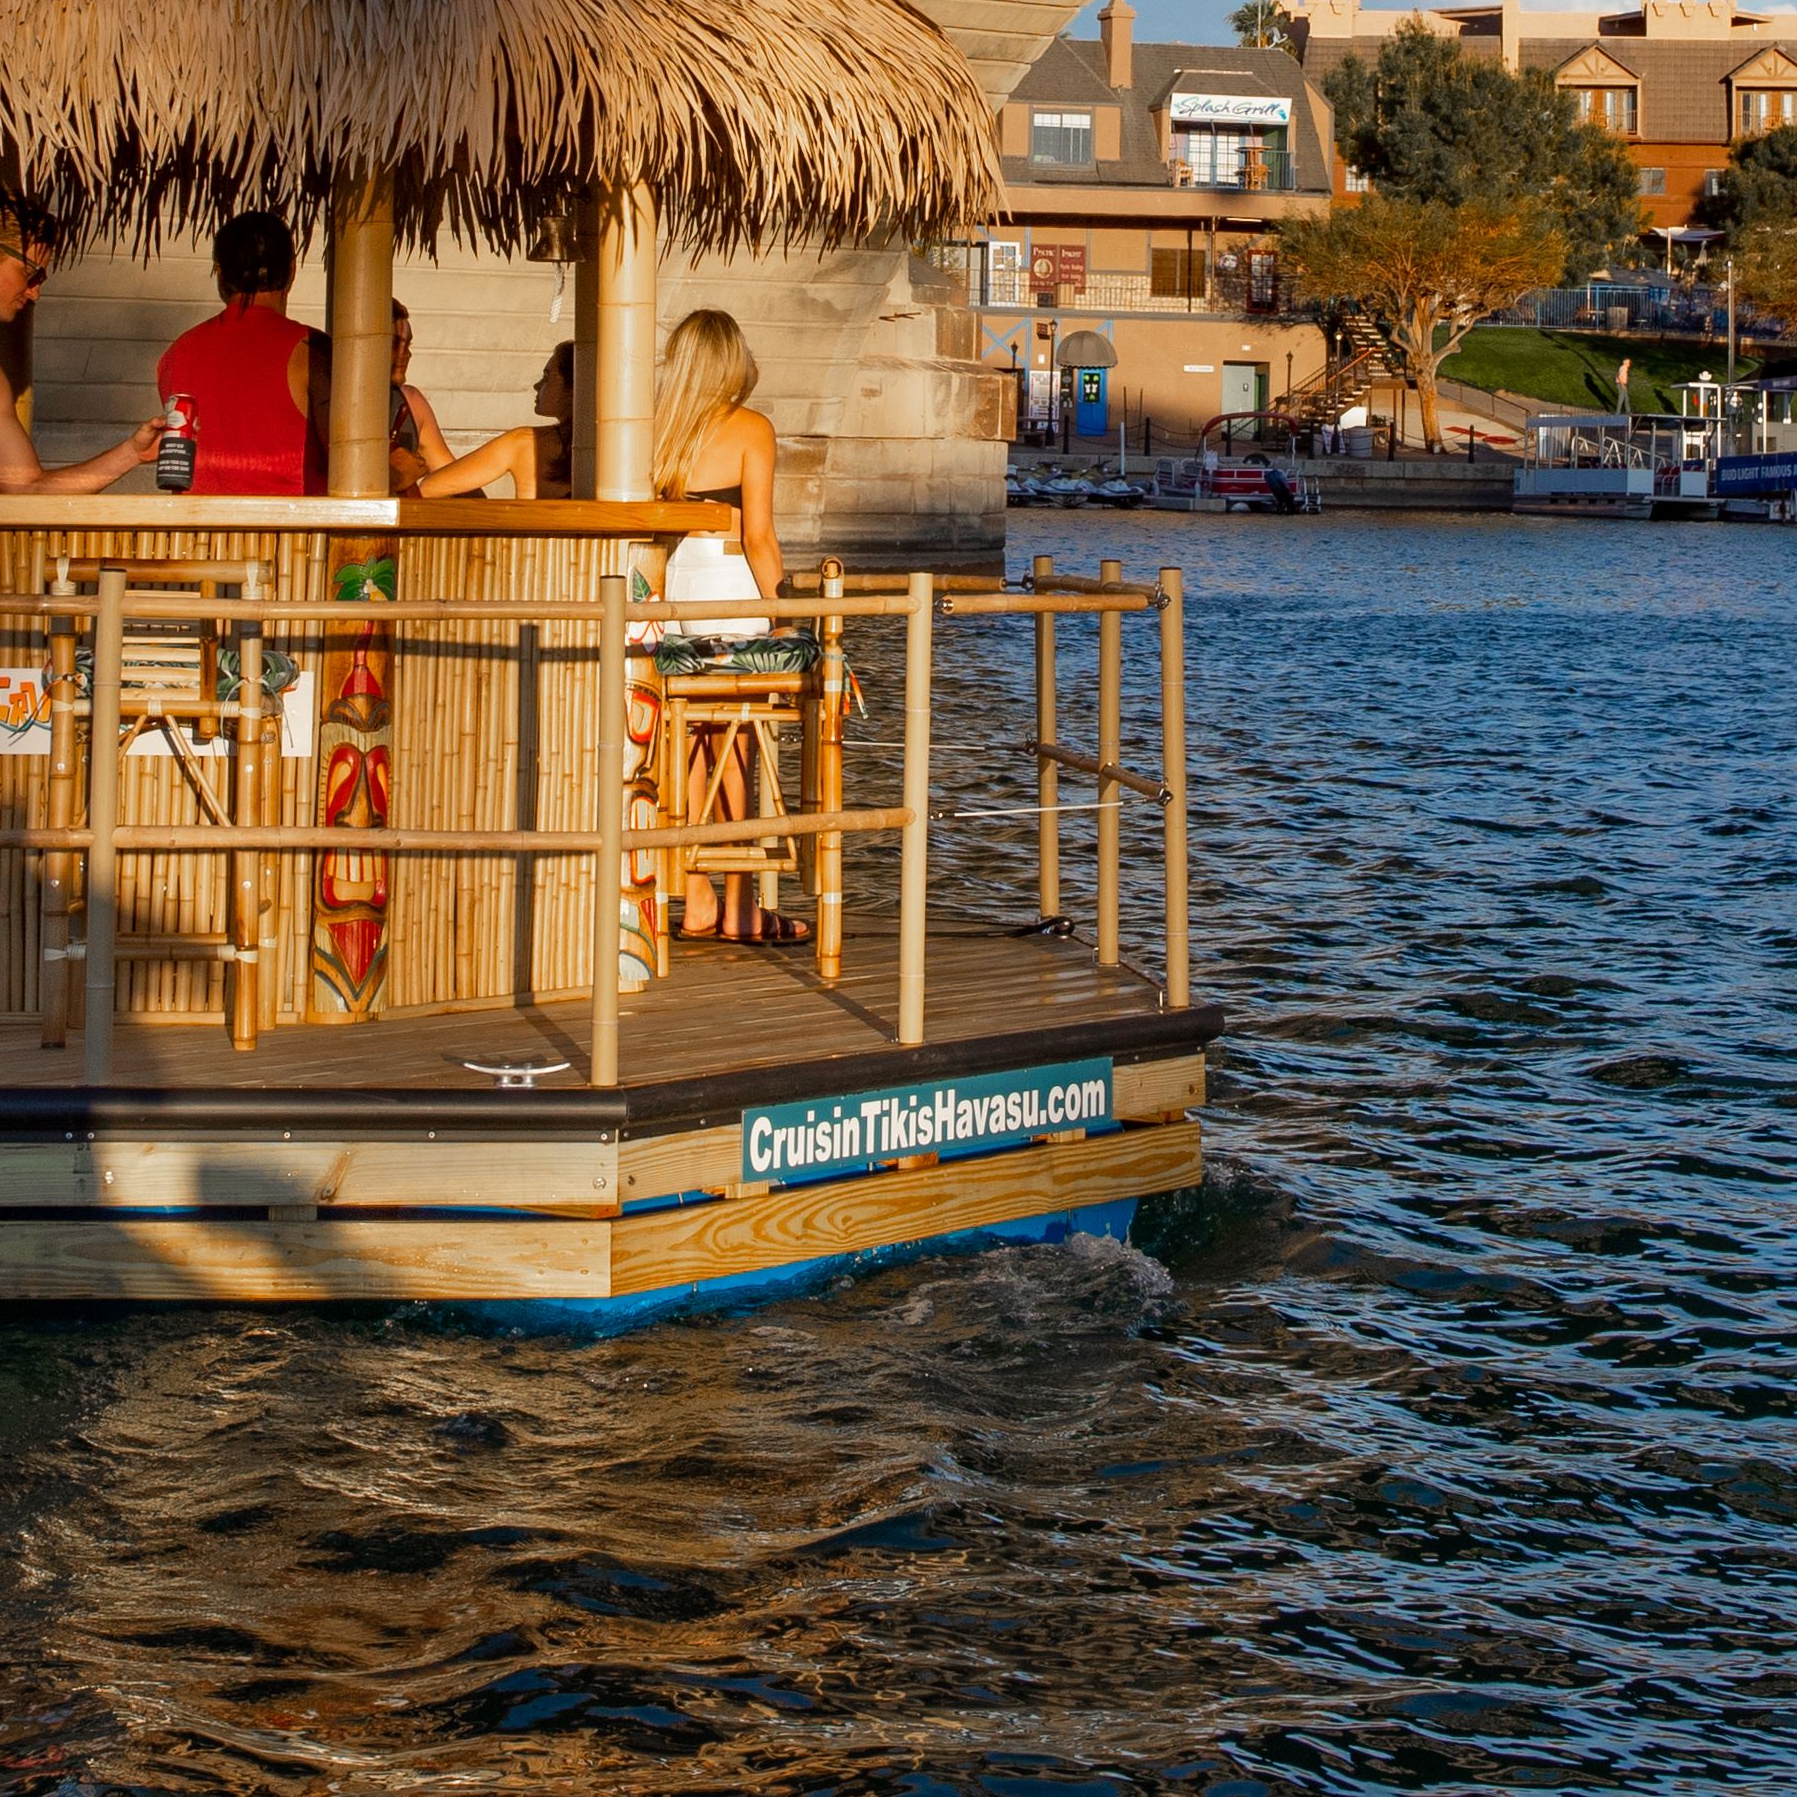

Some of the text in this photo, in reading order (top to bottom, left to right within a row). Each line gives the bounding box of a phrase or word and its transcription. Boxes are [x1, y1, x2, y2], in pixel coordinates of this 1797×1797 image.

[1179, 95, 1280, 116] Splash Grill
[1721, 469, 1737, 481] BUD
[1738, 467, 1759, 480] LIGHT
[1761, 465, 1792, 479] FAMOUS
[749, 1077, 1105, 1173] CruisinTikisHavasu.com
